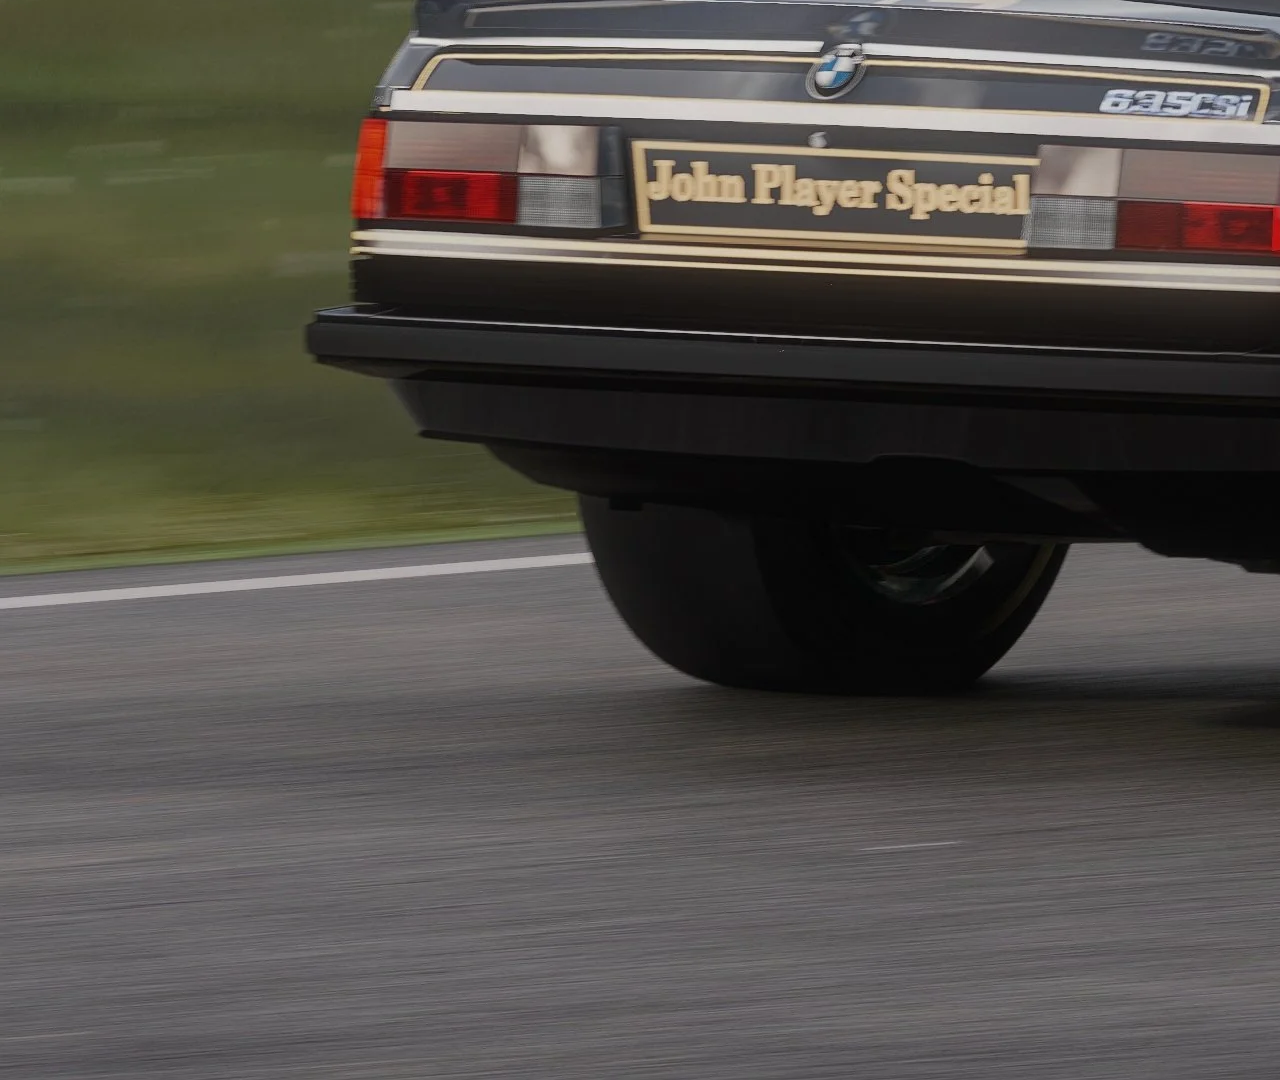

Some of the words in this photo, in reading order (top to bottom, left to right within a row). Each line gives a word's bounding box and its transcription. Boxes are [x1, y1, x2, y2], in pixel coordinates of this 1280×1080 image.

[647, 159, 748, 204] John
[750, 163, 883, 217] Player
[885, 168, 1031, 220] Special
